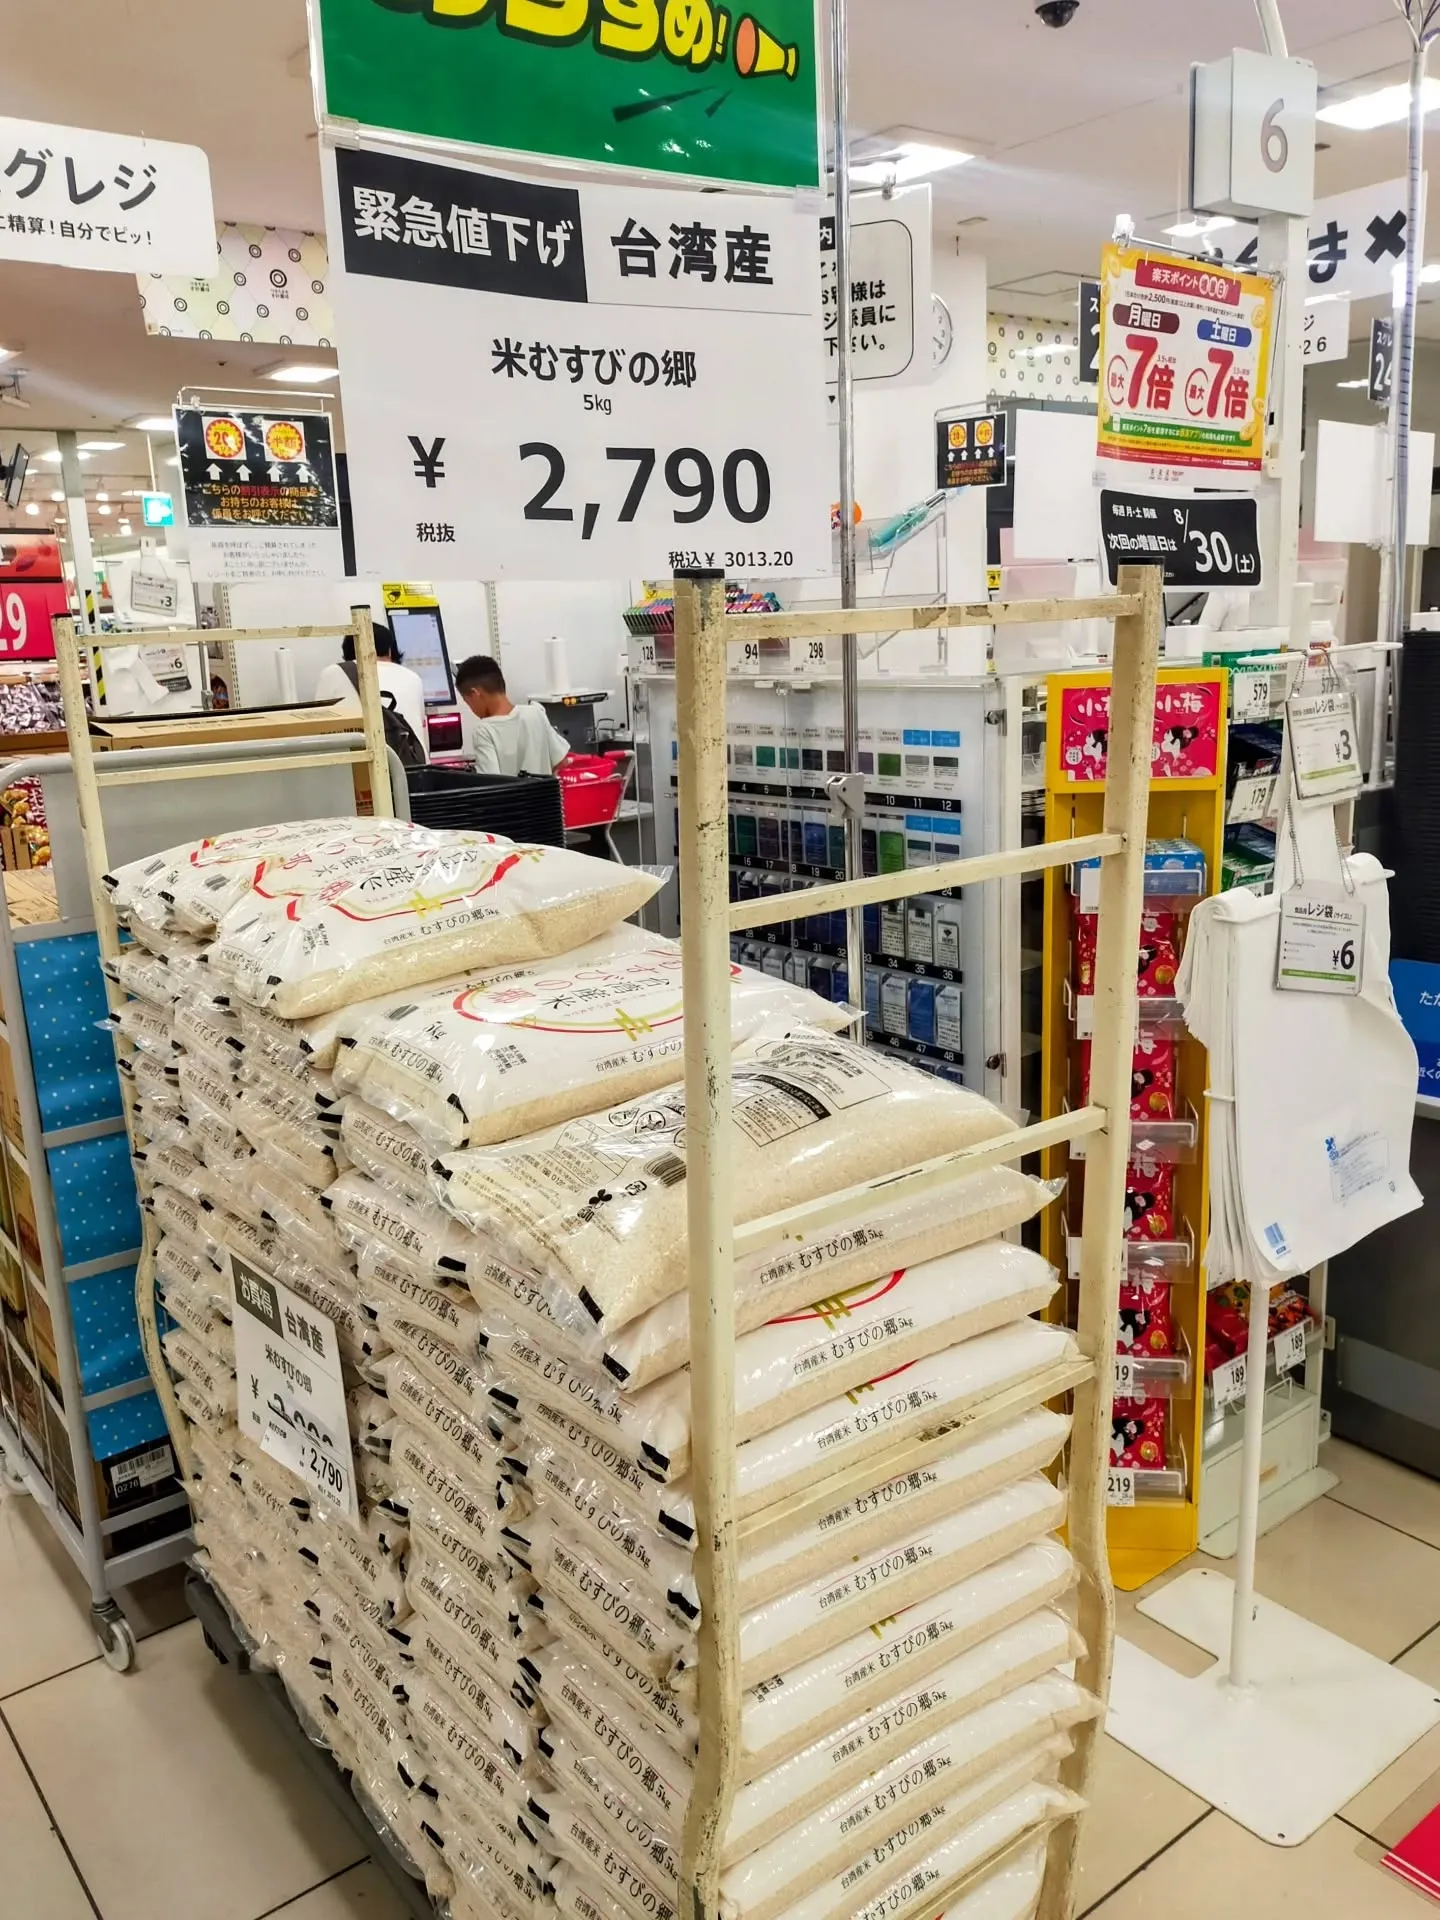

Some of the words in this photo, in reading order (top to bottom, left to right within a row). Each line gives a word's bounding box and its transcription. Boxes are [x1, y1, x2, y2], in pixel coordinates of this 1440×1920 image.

[1261, 98, 1288, 173] 6
[352, 186, 575, 268] 緊急値下げ
[610, 218, 775, 286] 台湾産
[491, 337, 697, 388] 米むすびの郷
[583, 395, 612, 415] 5kg
[408, 436, 446, 489] ¥
[519, 442, 771, 540] 2,790
[416, 523, 456, 543] 税抜
[724, 551, 793, 568] 3013.20
[745, 643, 758, 659] 94
[808, 642, 824, 659] 298
[1157, 691, 1204, 714] 小梅
[1253, 683, 1268, 701] 579
[886, 795, 896, 806] 10
[942, 800, 952, 811] 12
[1252, 787, 1267, 805] 179
[887, 958, 898, 969] 34
[915, 963, 925, 974] 35
[760, 1262, 796, 1286] 台湾産米
[798, 1228, 885, 1270] むすびの郷5kg
[284, 1304, 326, 1359] 台湾産
[1291, 1333, 1303, 1352] 189
[793, 1350, 828, 1375] 台湾産米
[831, 1316, 914, 1358] むすびの郷5kg
[1231, 1365, 1245, 1386] 189
[817, 1425, 852, 1449] 台湾産米
[854, 1390, 938, 1432] むすびの郷5kg
[310, 1447, 343, 1493] 2,790
[1107, 1476, 1131, 1493] 219
[817, 1507, 852, 1531] 台湾産米
[854, 1470, 938, 1515] むすびの郷5kg
[819, 1583, 852, 1609] 台湾産米
[853, 1544, 934, 1591] むすびの郷5kg
[844, 1662, 876, 1688] 台湾産米
[878, 1620, 955, 1668] むすびの郷5kg
[832, 1736, 865, 1764] 台湾産米
[867, 1690, 948, 1742] むすびの郷5kg
[839, 1806, 872, 1834] 台湾産米
[874, 1755, 952, 1811] むすびの郷5kg
[840, 1860, 872, 1889] 台湾産米
